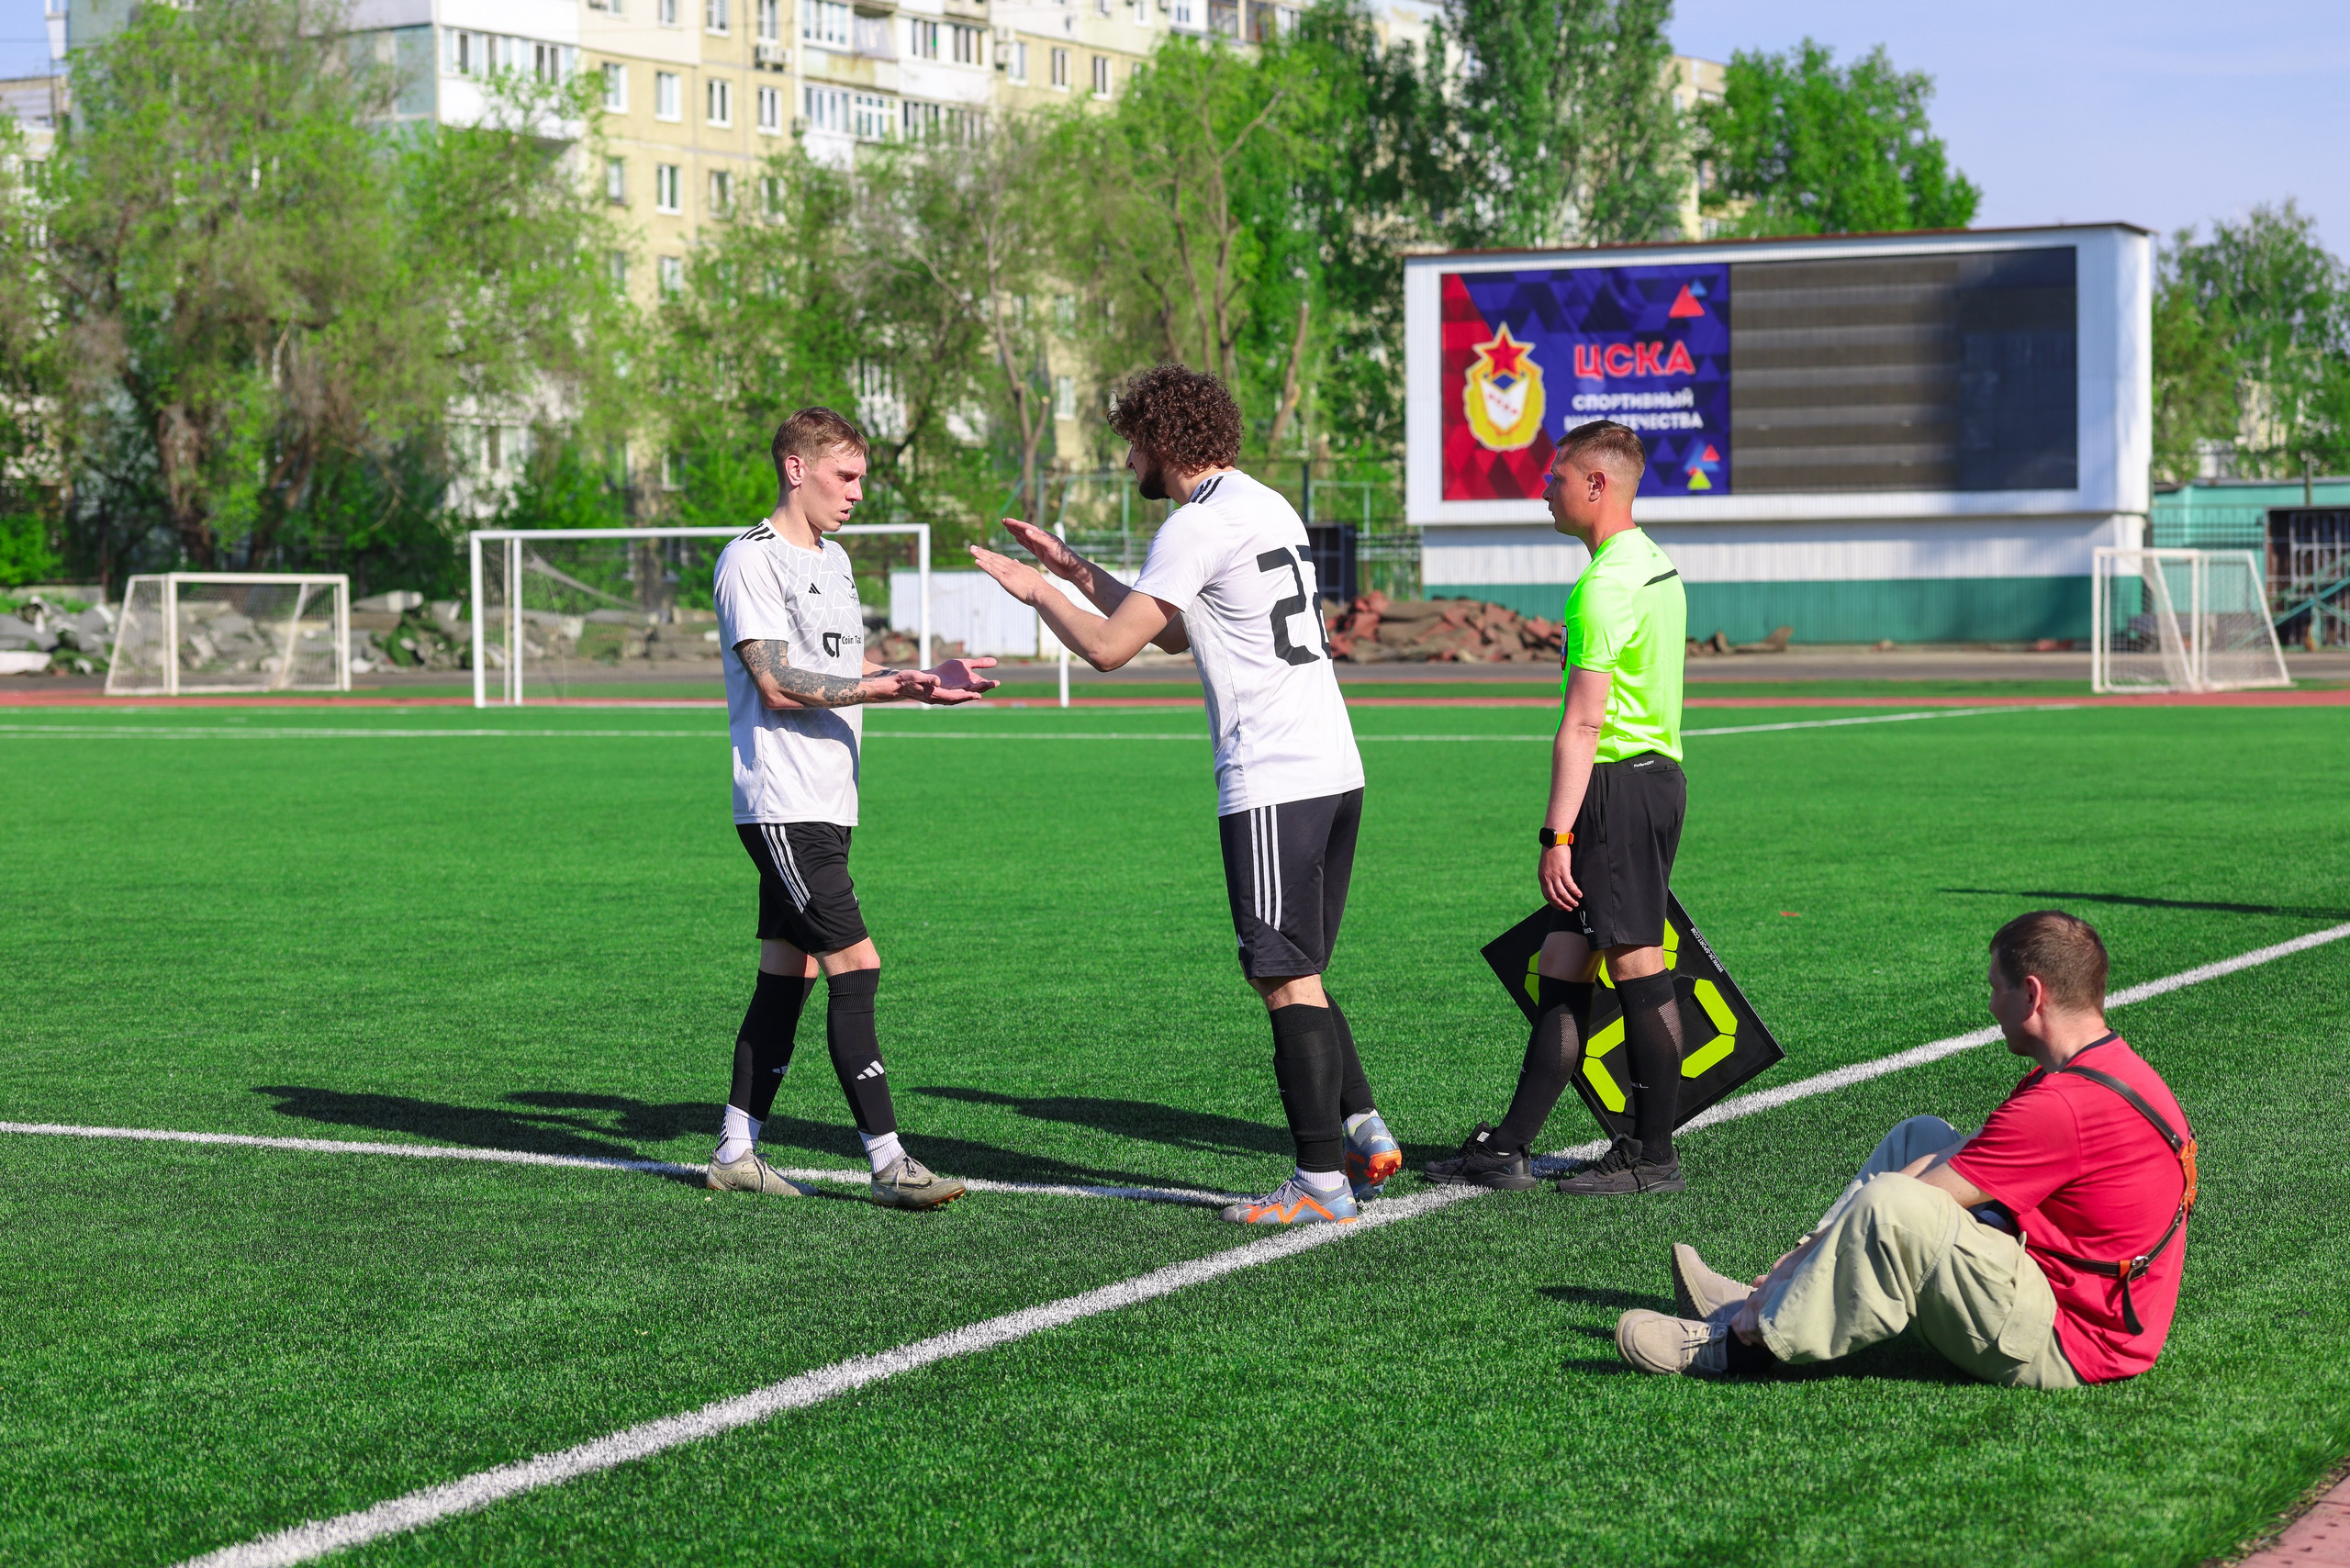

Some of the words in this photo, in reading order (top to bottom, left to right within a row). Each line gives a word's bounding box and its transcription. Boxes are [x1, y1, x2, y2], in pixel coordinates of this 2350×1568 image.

[1574, 340, 1695, 380] ЦСКА
[1572, 387, 1695, 411] СПОРТИВНЫЙ
[1690, 927, 1724, 973] WWW.2K-SPORT.COM
